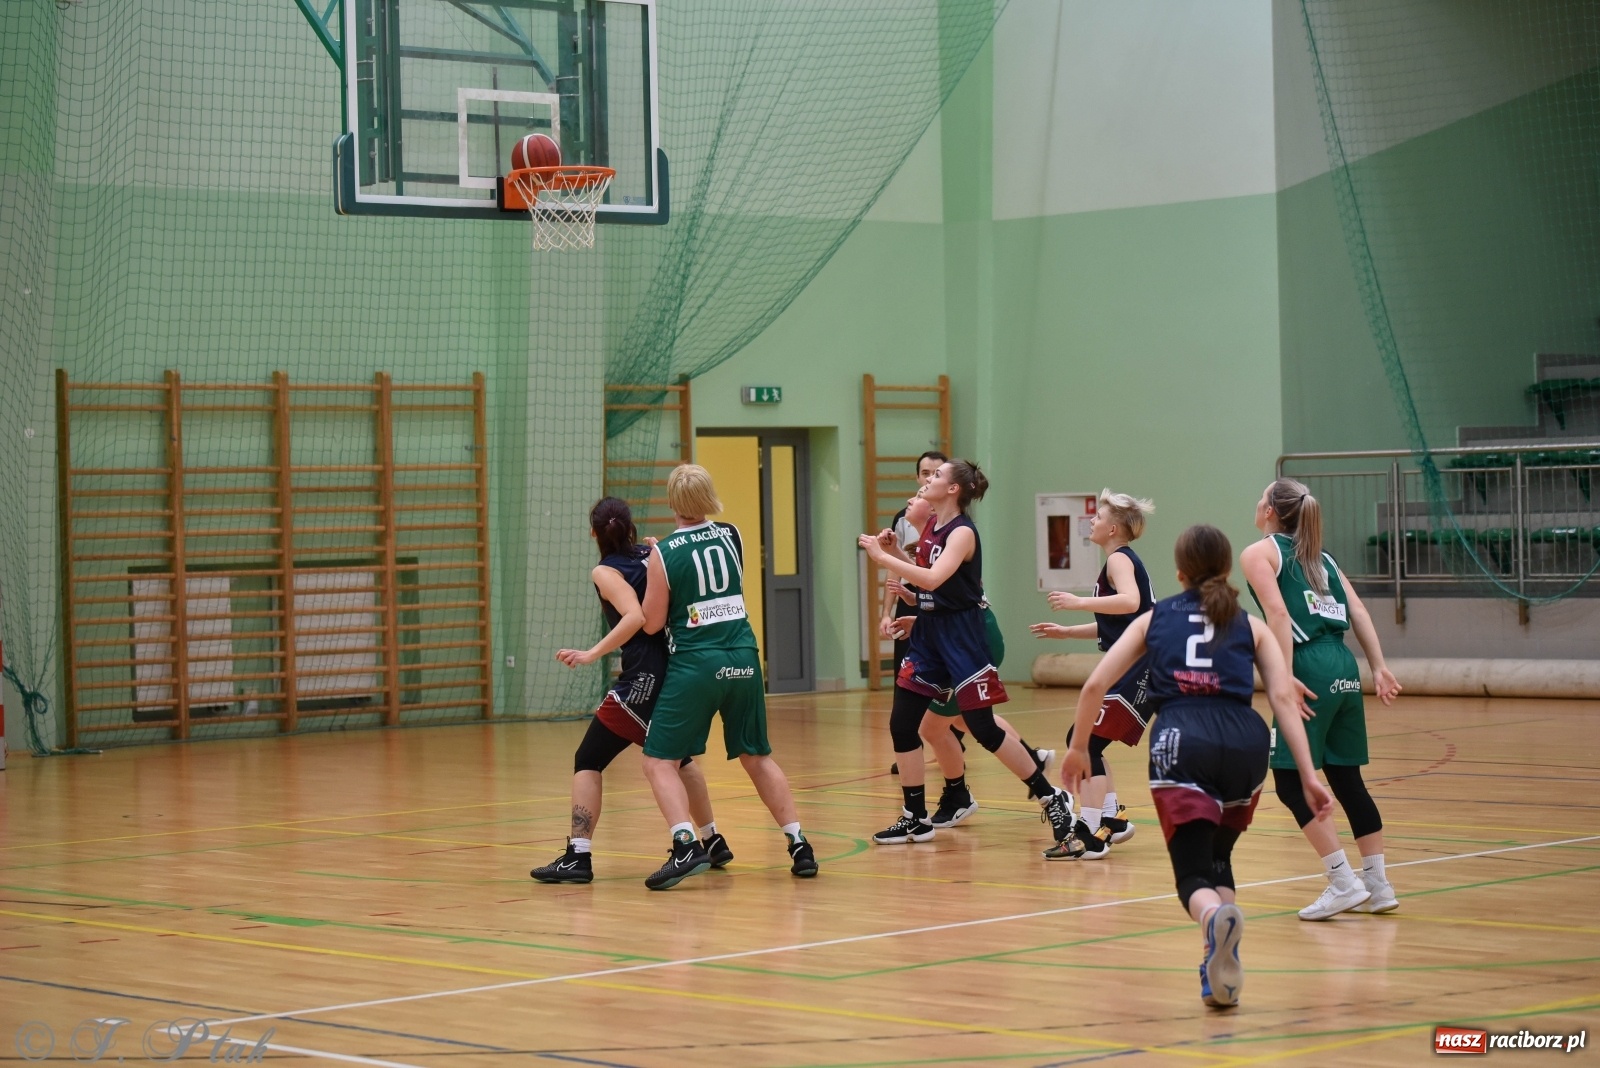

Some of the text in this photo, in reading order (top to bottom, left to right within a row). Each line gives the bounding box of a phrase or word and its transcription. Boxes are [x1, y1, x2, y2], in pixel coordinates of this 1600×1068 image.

[668, 535, 688, 550] RKK
[692, 545, 729, 597] 10
[699, 605, 744, 620] WAGTECH
[1185, 613, 1215, 668] 2
[725, 665, 754, 677] Clavis
[976, 682, 991, 701] 12
[1339, 678, 1361, 691] Clavis
